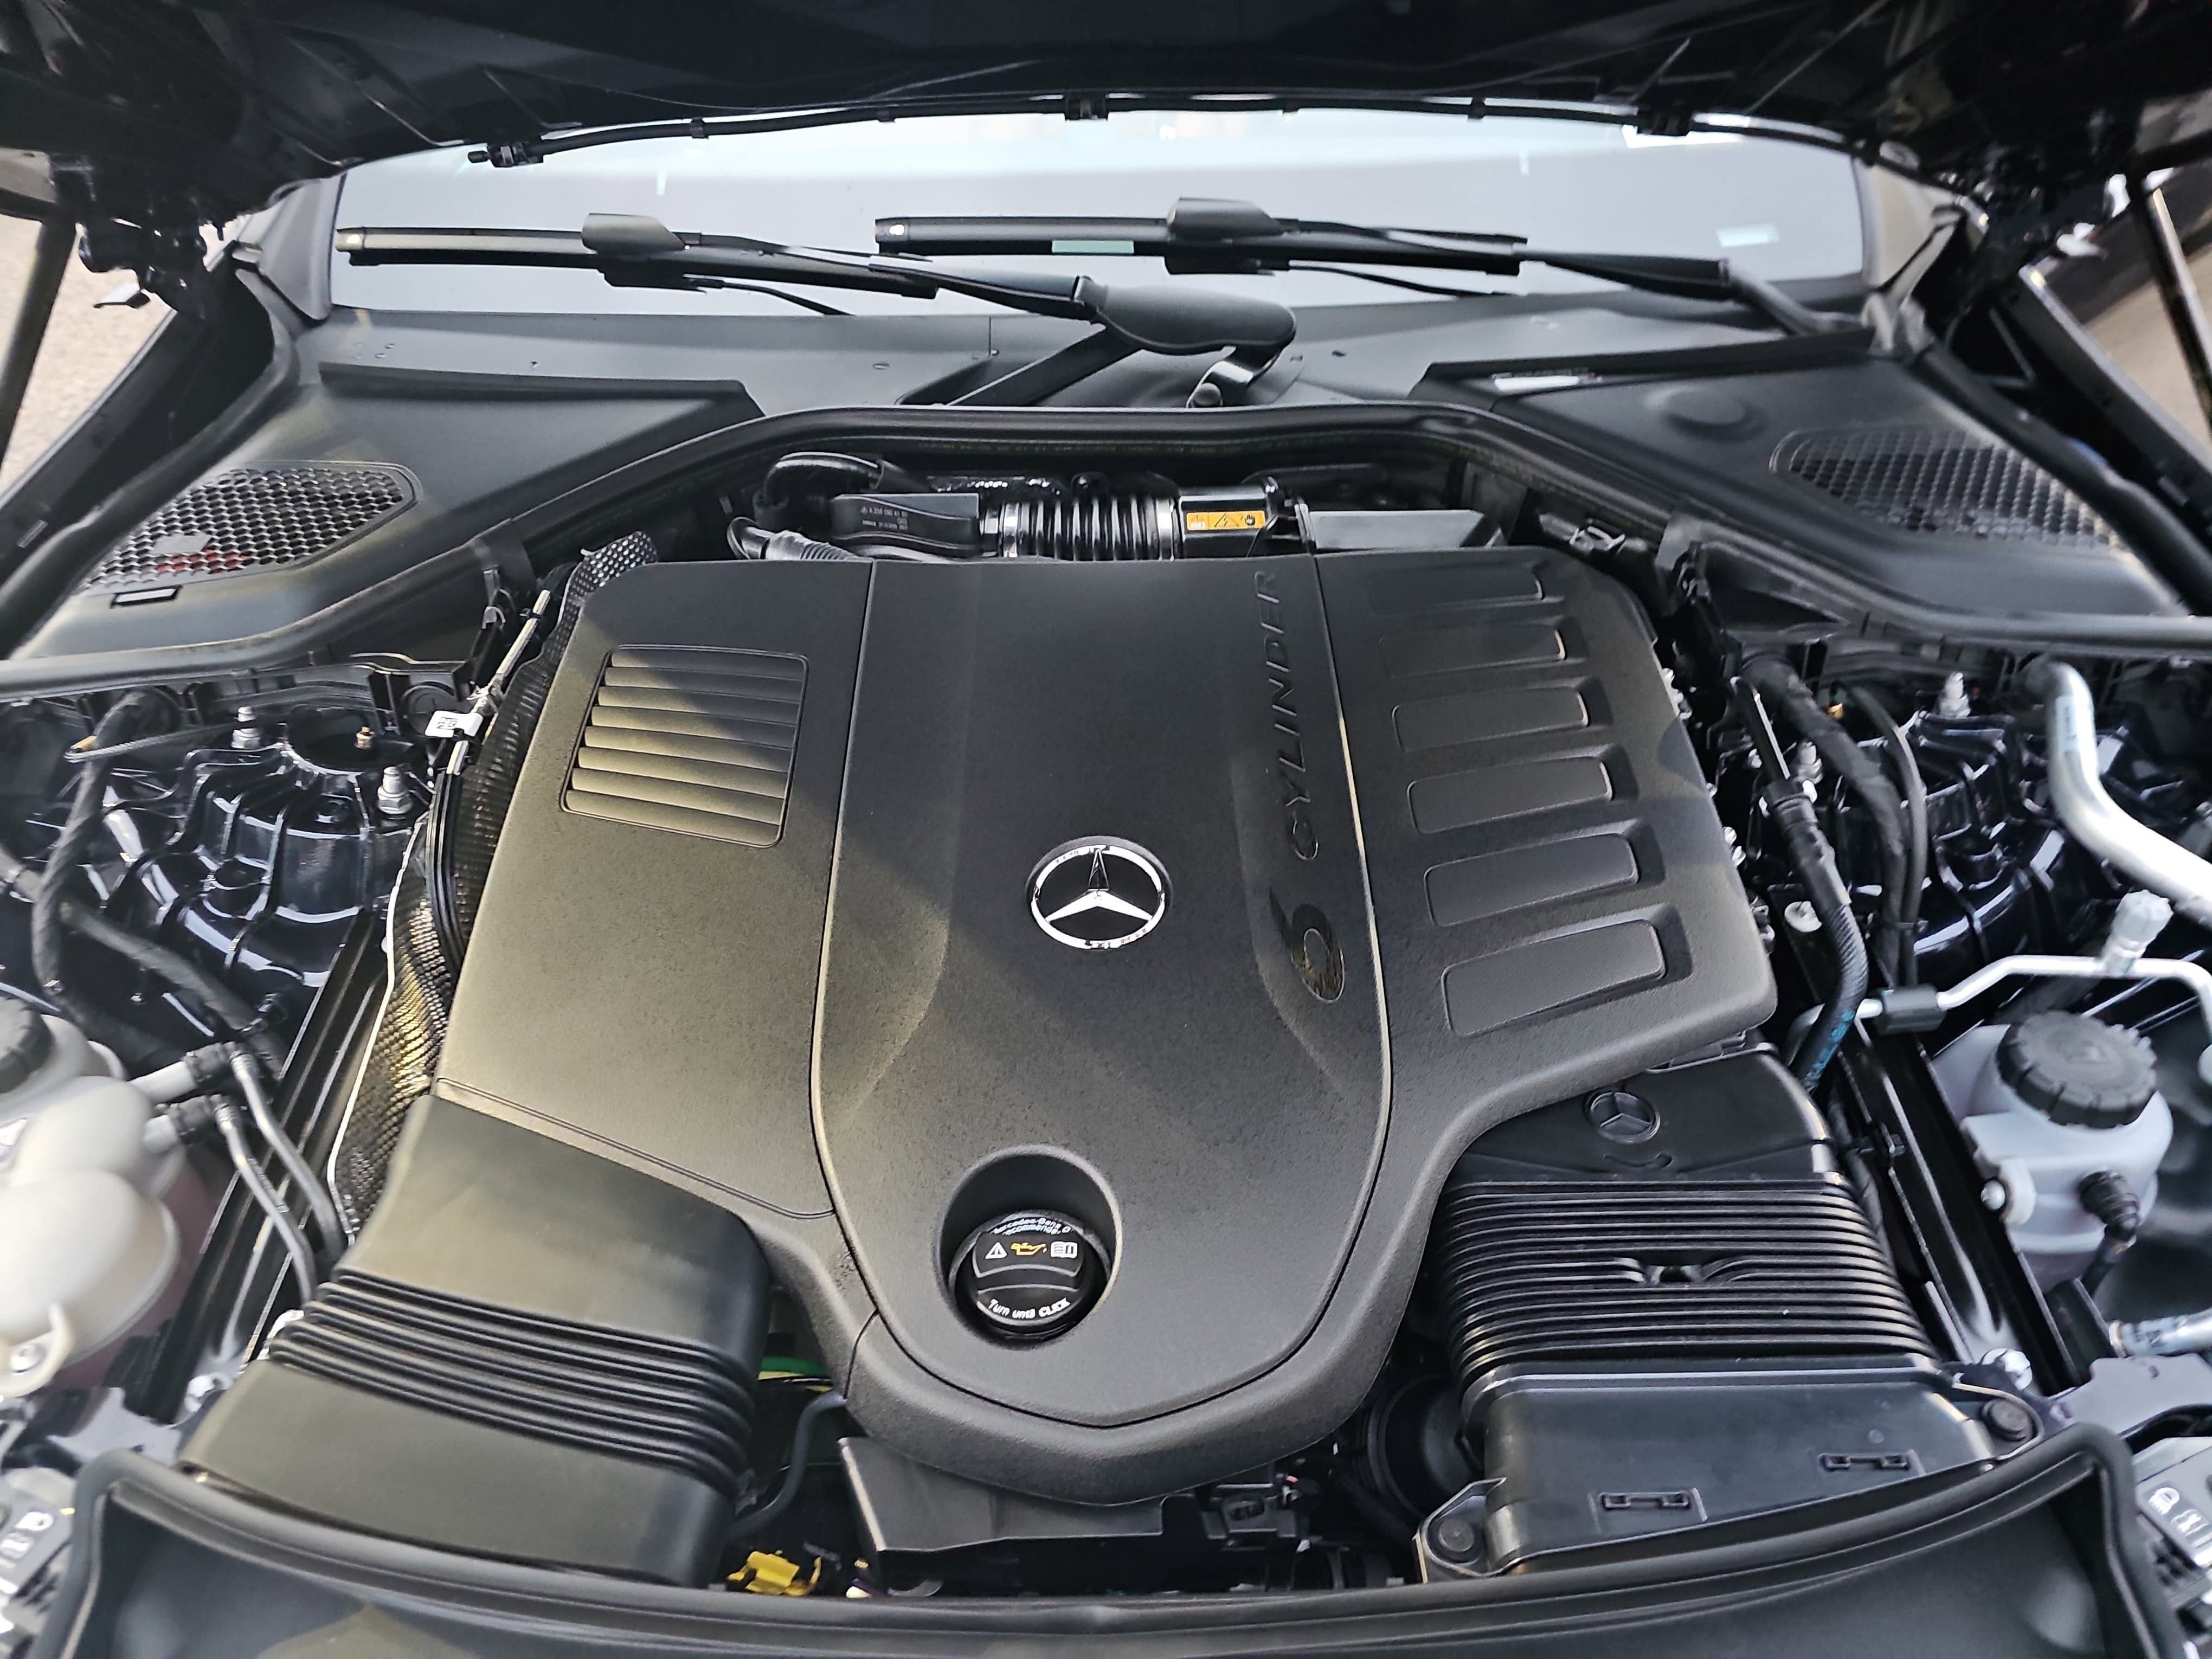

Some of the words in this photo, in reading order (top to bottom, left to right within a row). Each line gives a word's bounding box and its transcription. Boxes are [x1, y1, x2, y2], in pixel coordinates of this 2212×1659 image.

[1254, 571, 1319, 860] CYLINDER
[1269, 885, 1346, 1004] 6
[988, 1298, 1010, 1316] Turn
[1012, 1308, 1036, 1319] until
[1038, 1297, 1071, 1317] CLICK
